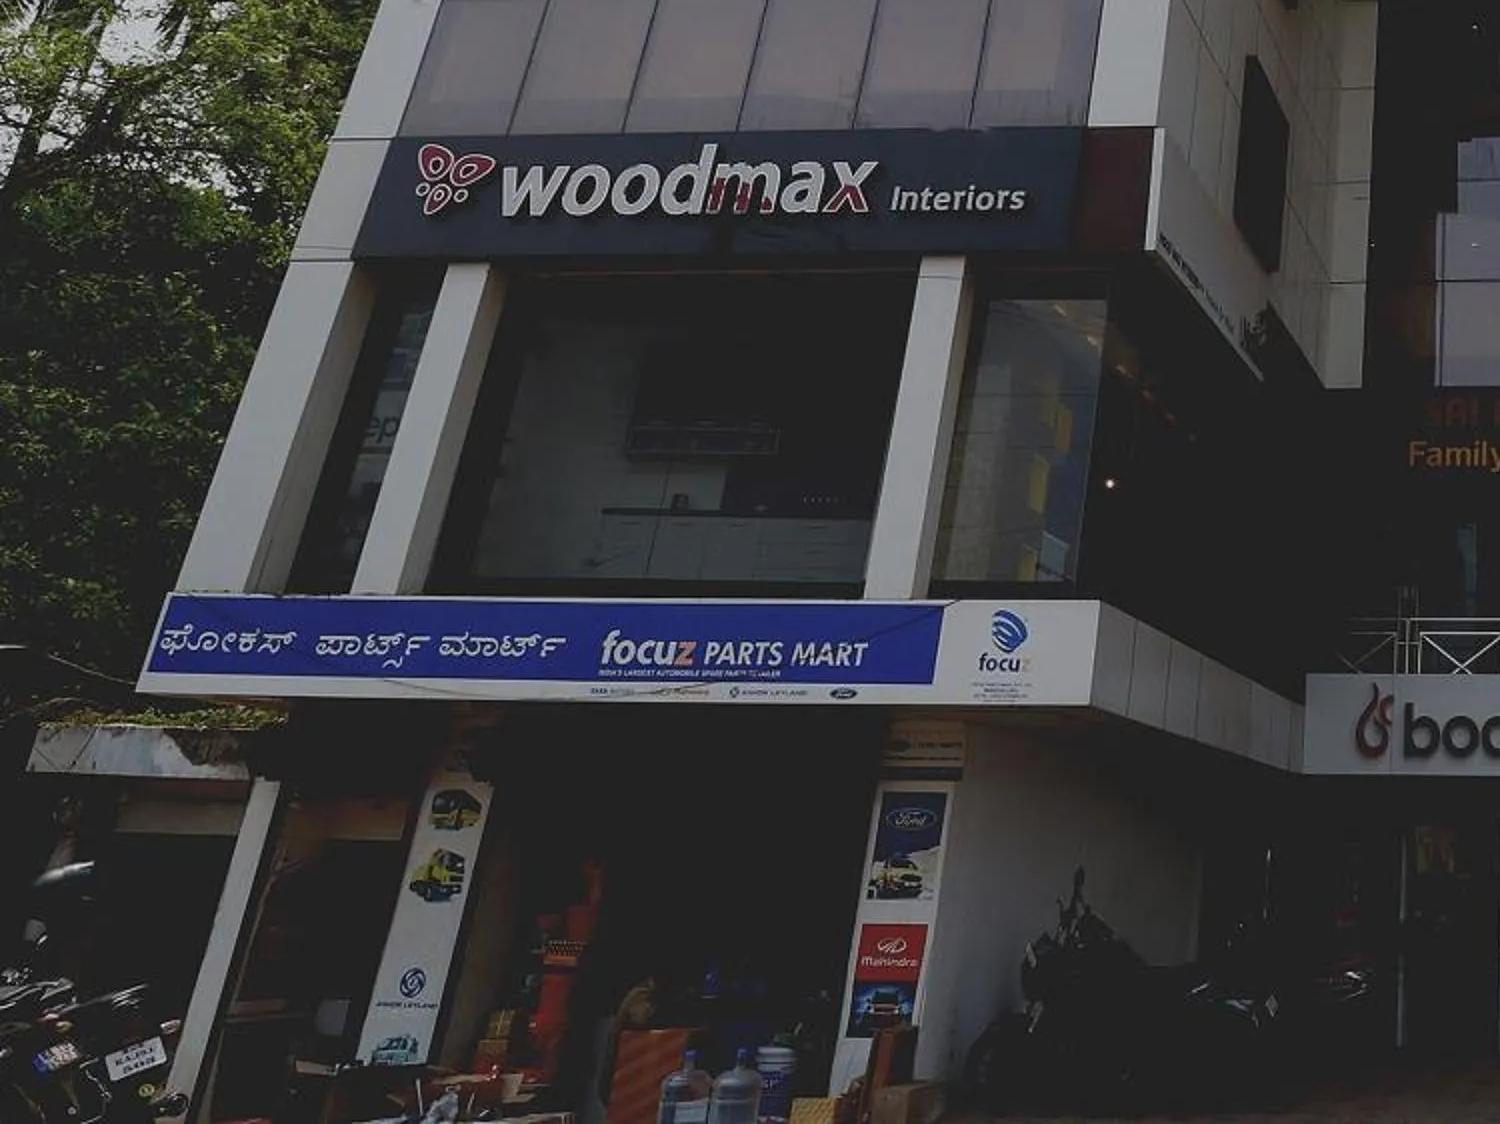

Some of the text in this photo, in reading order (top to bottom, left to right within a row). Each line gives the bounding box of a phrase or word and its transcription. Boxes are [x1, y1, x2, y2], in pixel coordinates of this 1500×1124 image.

[501, 142, 1027, 218] woodmax Interiors
[601, 629, 869, 668] focuz PARTS MART
